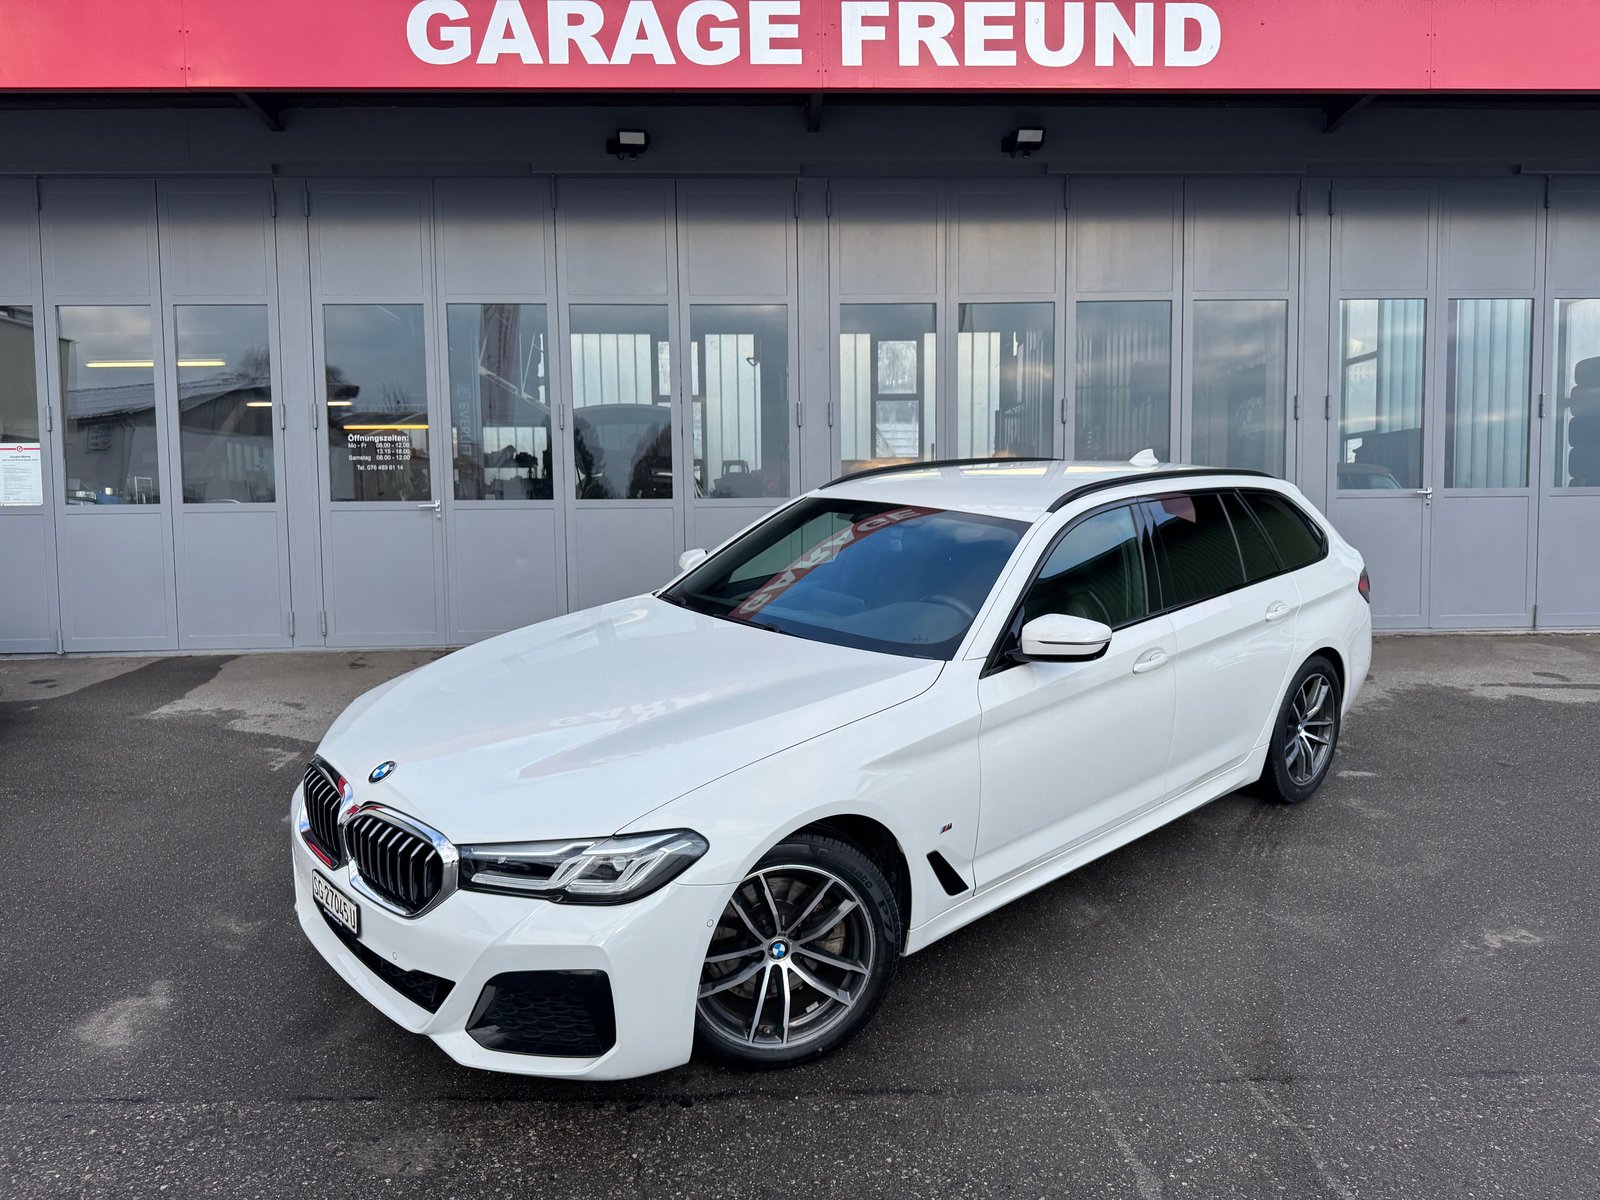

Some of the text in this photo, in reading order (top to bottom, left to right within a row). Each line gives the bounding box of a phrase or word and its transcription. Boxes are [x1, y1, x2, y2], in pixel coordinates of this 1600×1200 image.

[406, 0, 1222, 67] GARAGE FREUND
[347, 434, 409, 443] Öffnungszeiten:
